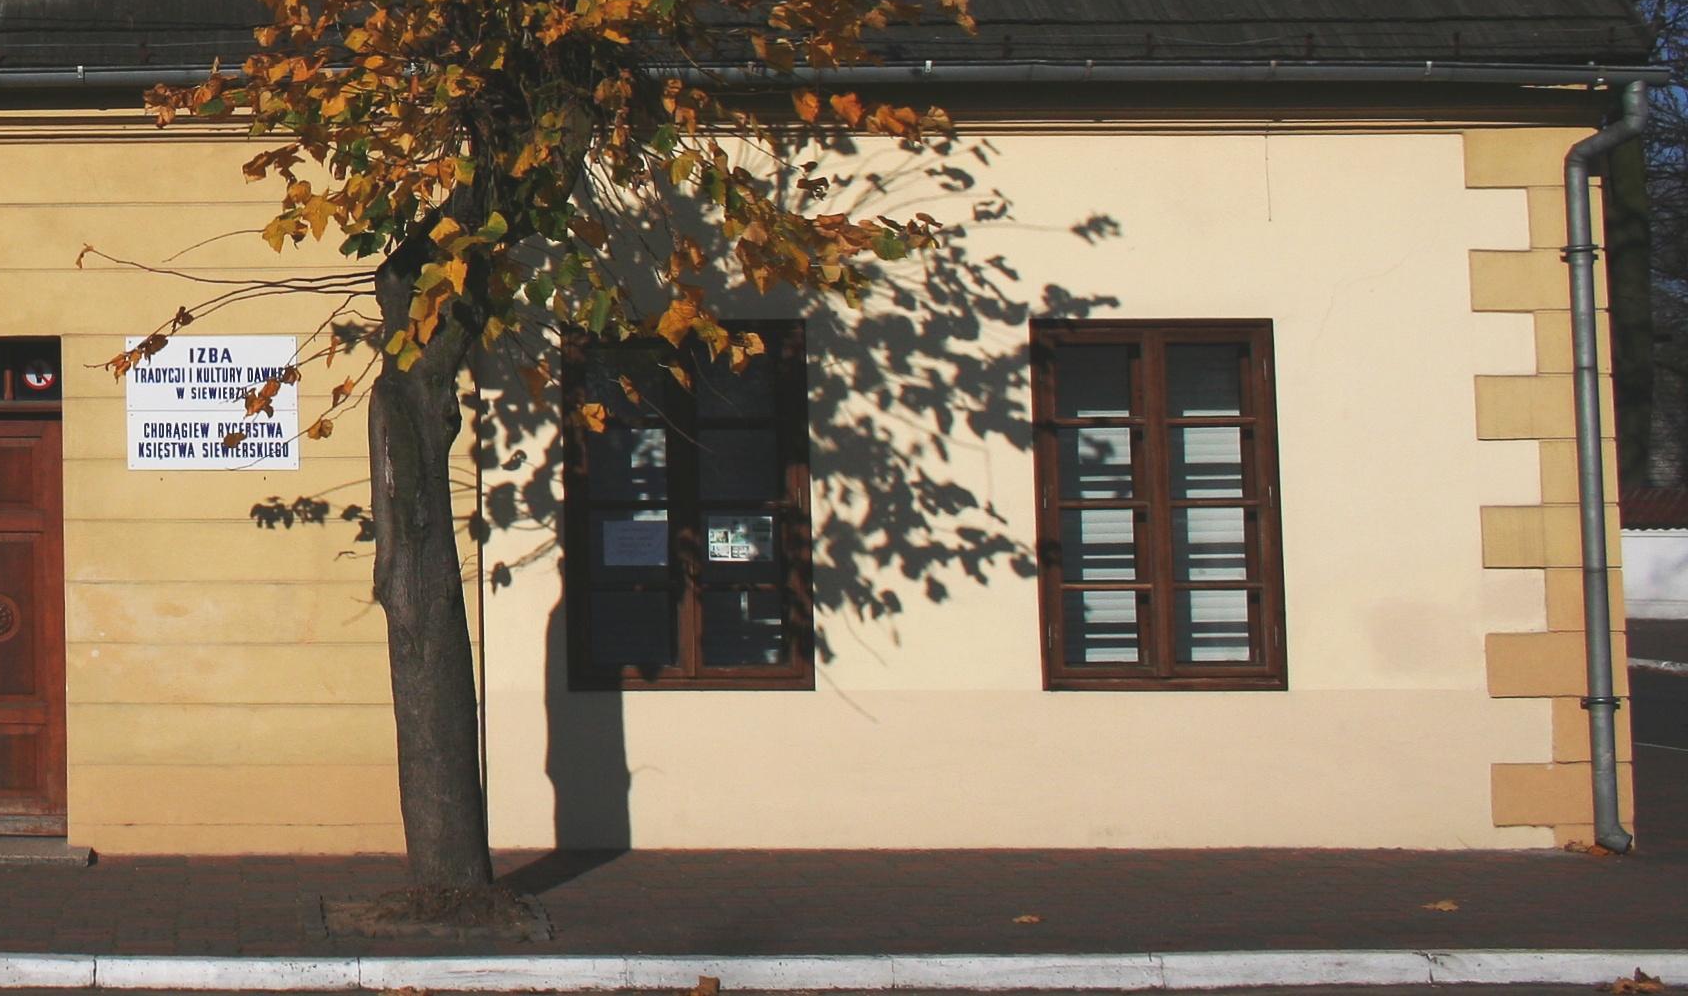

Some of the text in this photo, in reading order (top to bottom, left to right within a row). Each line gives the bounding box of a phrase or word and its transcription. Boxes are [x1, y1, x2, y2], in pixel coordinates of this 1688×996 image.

[189, 347, 233, 363] IZBA
[134, 367, 186, 383] TRADYCJI
[188, 367, 193, 383] I
[196, 367, 242, 383] KULTURY
[176, 387, 185, 399] W
[143, 422, 210, 441] CHORĄGIEW
[138, 442, 289, 460] KSIĘSTWA SIEWIERSKIEGO
